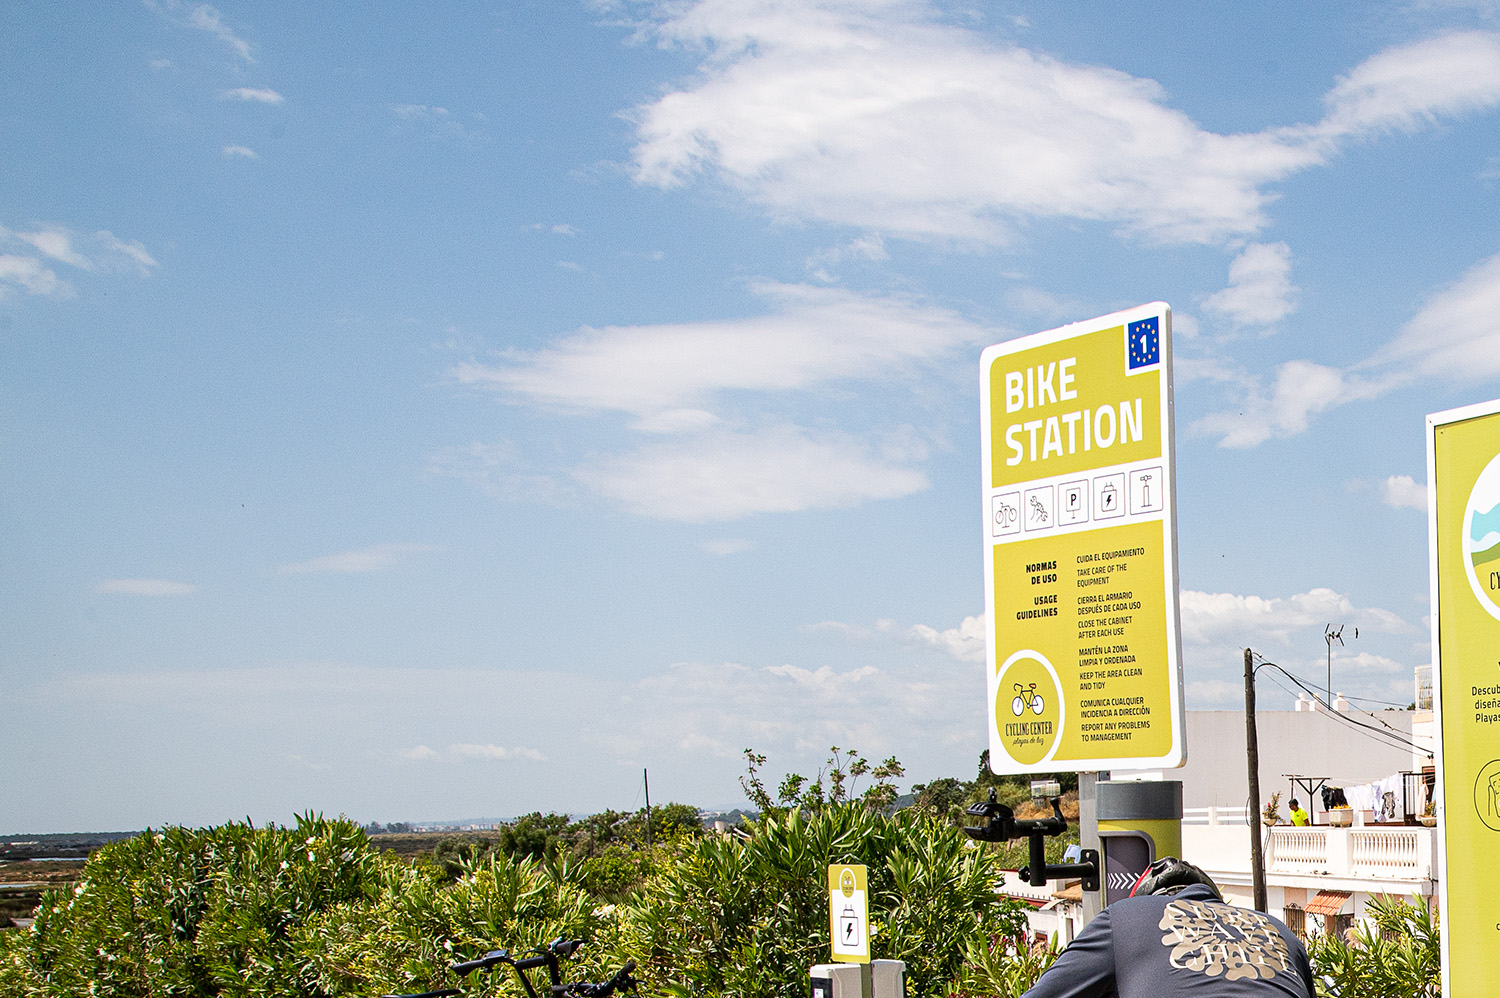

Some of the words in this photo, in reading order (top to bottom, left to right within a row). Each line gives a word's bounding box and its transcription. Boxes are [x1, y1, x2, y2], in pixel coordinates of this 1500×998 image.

[1139, 334, 1148, 354] 1
[1005, 357, 1078, 414] BIKE
[1005, 398, 1143, 467] STATION
[1070, 493, 1077, 506] P
[1076, 554, 1093, 564] CUIDA
[1094, 553, 1101, 562] EL
[1101, 547, 1145, 561] EQUIPAMIENTO
[1026, 560, 1057, 573] NORMAS
[1077, 568, 1091, 577] TAKE
[1091, 566, 1106, 575] CARE
[1107, 565, 1115, 573] OF
[1116, 563, 1127, 572] THE
[1031, 575, 1041, 585] DE
[1042, 573, 1057, 584] USO
[1077, 576, 1109, 588] EQUIPMENT
[1034, 594, 1058, 606] USAGE
[1016, 607, 1058, 620] GUIDELINES
[1078, 619, 1095, 629] CLOSE
[1096, 618, 1107, 626] THE
[1108, 616, 1132, 626] CABINET
[1078, 630, 1096, 639] AFTER
[1097, 629, 1112, 637] EACH
[1113, 627, 1124, 636] USE
[1081, 709, 1113, 718] INCIDENCIA
[1119, 707, 1150, 716] DIRECCIÓN
[1005, 722, 1029, 737] CYCLING
[1030, 721, 1053, 736] CENTER
[1081, 723, 1103, 731] REPORT
[1104, 722, 1117, 730] ANY
[1118, 720, 1150, 729] PROBLEMS
[1012, 737, 1029, 748] playas
[1029, 736, 1035, 744] de
[1036, 736, 1044, 746] luz
[1081, 734, 1089, 742] TO
[1090, 732, 1132, 741] MANAGEMENT
[1166, 902, 1269, 930] SURF
[1170, 922, 1279, 945] WAVE
[1169, 943, 1298, 976] CHILL
